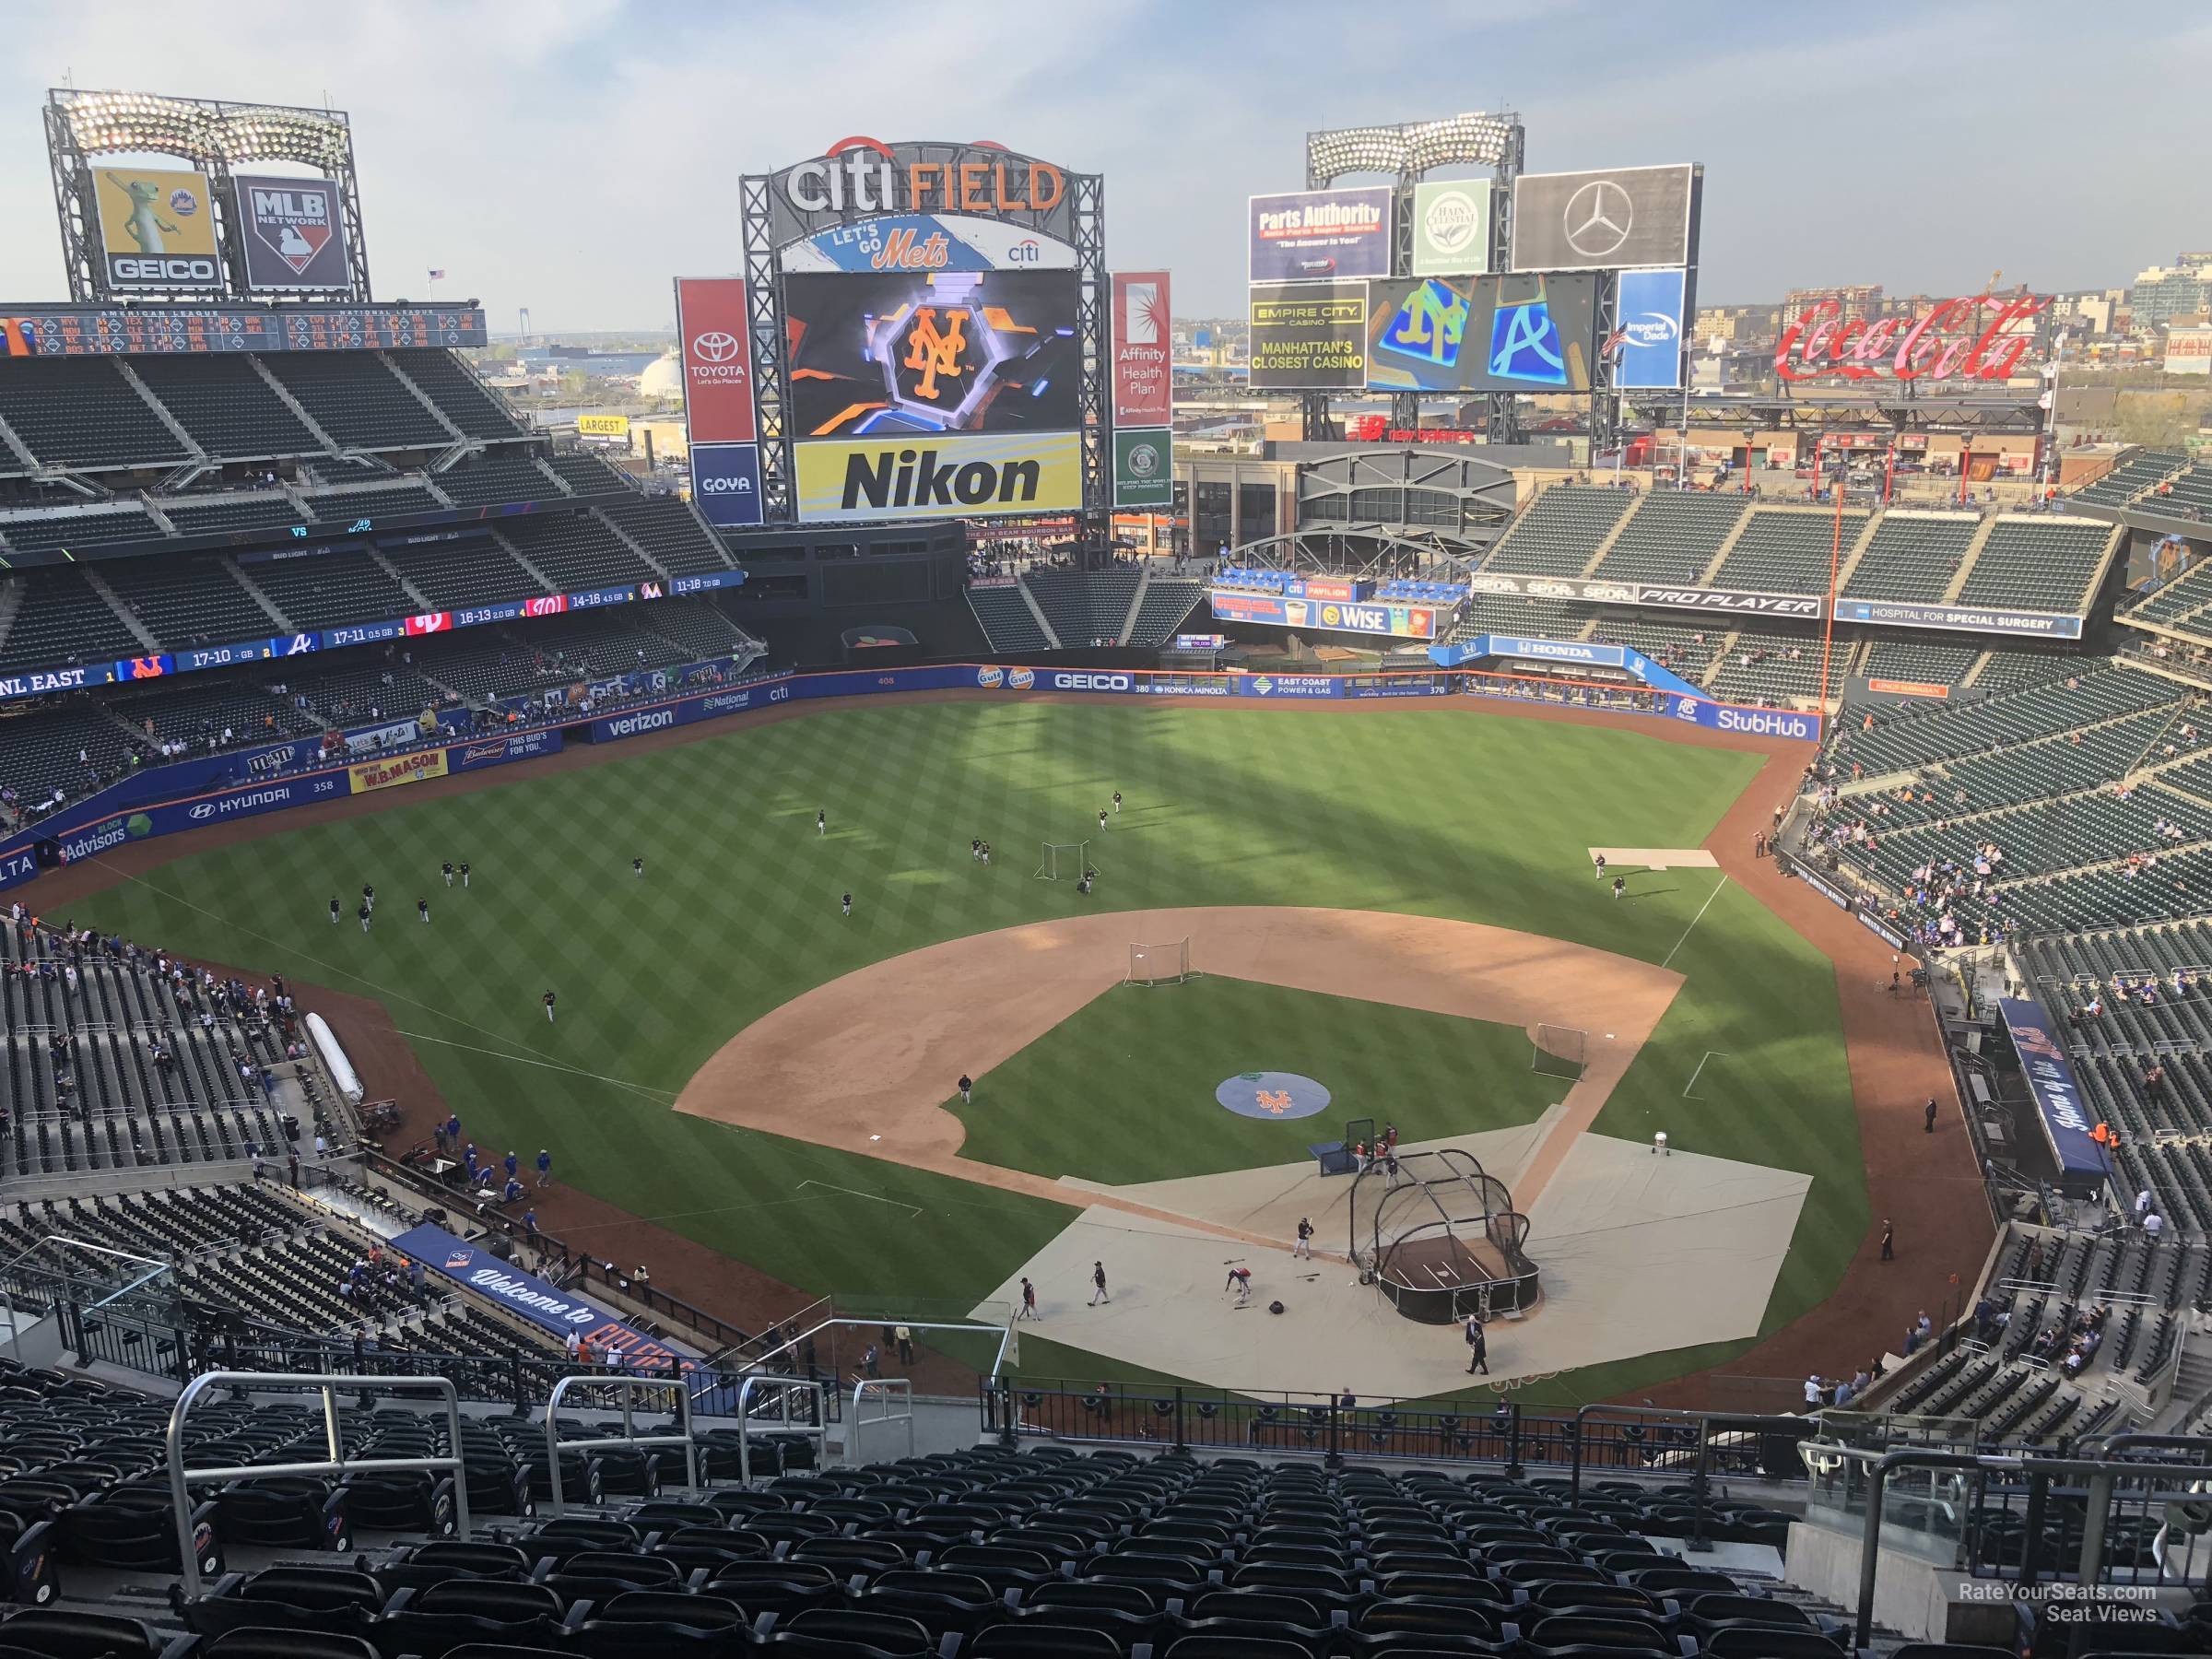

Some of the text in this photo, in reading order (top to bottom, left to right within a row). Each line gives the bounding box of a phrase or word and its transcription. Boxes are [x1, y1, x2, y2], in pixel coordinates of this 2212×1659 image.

[787, 149, 1064, 212] citi FIELD
[256, 190, 325, 218] MLB
[1439, 206, 1465, 217] HAIN
[257, 215, 326, 227] NETWORK
[1259, 203, 1381, 230] Parts Authority
[1426, 214, 1476, 227] CELESTIAL
[832, 224, 878, 246] LET'S
[859, 239, 882, 254] GO
[871, 228, 949, 269] Mets
[1297, 239, 1329, 247] Answer
[1008, 244, 1039, 262] citi
[114, 258, 215, 280] GEICO
[1258, 308, 1317, 319] EMPIRE
[1627, 322, 1666, 333] Imperial
[1262, 340, 1353, 355] MANHATTAN'S
[1120, 348, 1165, 363] Affinity
[1252, 355, 1363, 370] CLOSEST CASINO
[691, 365, 746, 377] TOYOTA
[1123, 367, 1162, 380] Health
[1130, 382, 1156, 395] Plan
[582, 419, 620, 431] LARGEST
[702, 477, 750, 492] GOYA
[841, 449, 1041, 509] Nikon
[291, 526, 307, 537] VS
[1308, 586, 1347, 597] PAVILION
[1639, 590, 1818, 614] PRO PLAYER
[1341, 606, 1386, 630] WISE
[1872, 608, 2053, 630] HOSPITAL FOR SPECIAL SURGERY
[31, 669, 85, 691] EAST
[106, 671, 114, 682] 1
[193, 649, 231, 666] 17-10
[241, 650, 253, 660] GB
[263, 648, 270, 657] 2
[334, 629, 366, 644] 17-11
[369, 629, 381, 639] 0.5
[382, 628, 393, 637] GB
[398, 627, 405, 636] 3
[492, 611, 503, 619] 2.0
[504, 609, 515, 618] GB
[628, 593, 634, 601] 5
[1532, 643, 1594, 658] HONDA
[979, 669, 1004, 684] Gulf
[1008, 669, 1035, 685] Gulf
[1054, 673, 1128, 690] GEICO
[1277, 677, 1331, 687] EAST COAST
[770, 686, 789, 700] citi
[1135, 685, 1149, 693] 380
[1194, 687, 1228, 695] MINOLTA
[1430, 686, 1445, 694] 370
[713, 691, 749, 708] National
[608, 709, 674, 736] verizon
[1717, 710, 1806, 737] StubHub
[508, 731, 547, 747] THIS BUD'S
[465, 746, 505, 759] Budweiser
[510, 742, 542, 756] FOR YOU.
[390, 753, 439, 780] MASON
[313, 782, 334, 794] 358
[219, 786, 290, 813] HYUNDAI
[98, 818, 123, 834] BLOCK
[65, 828, 125, 862] Advisors
[2031, 1060, 2062, 1079] the
[2033, 1078, 2073, 1093] of
[2048, 1093, 2090, 1132] Home
[470, 1267, 570, 1315] Welcome
[561, 1307, 595, 1324] to
